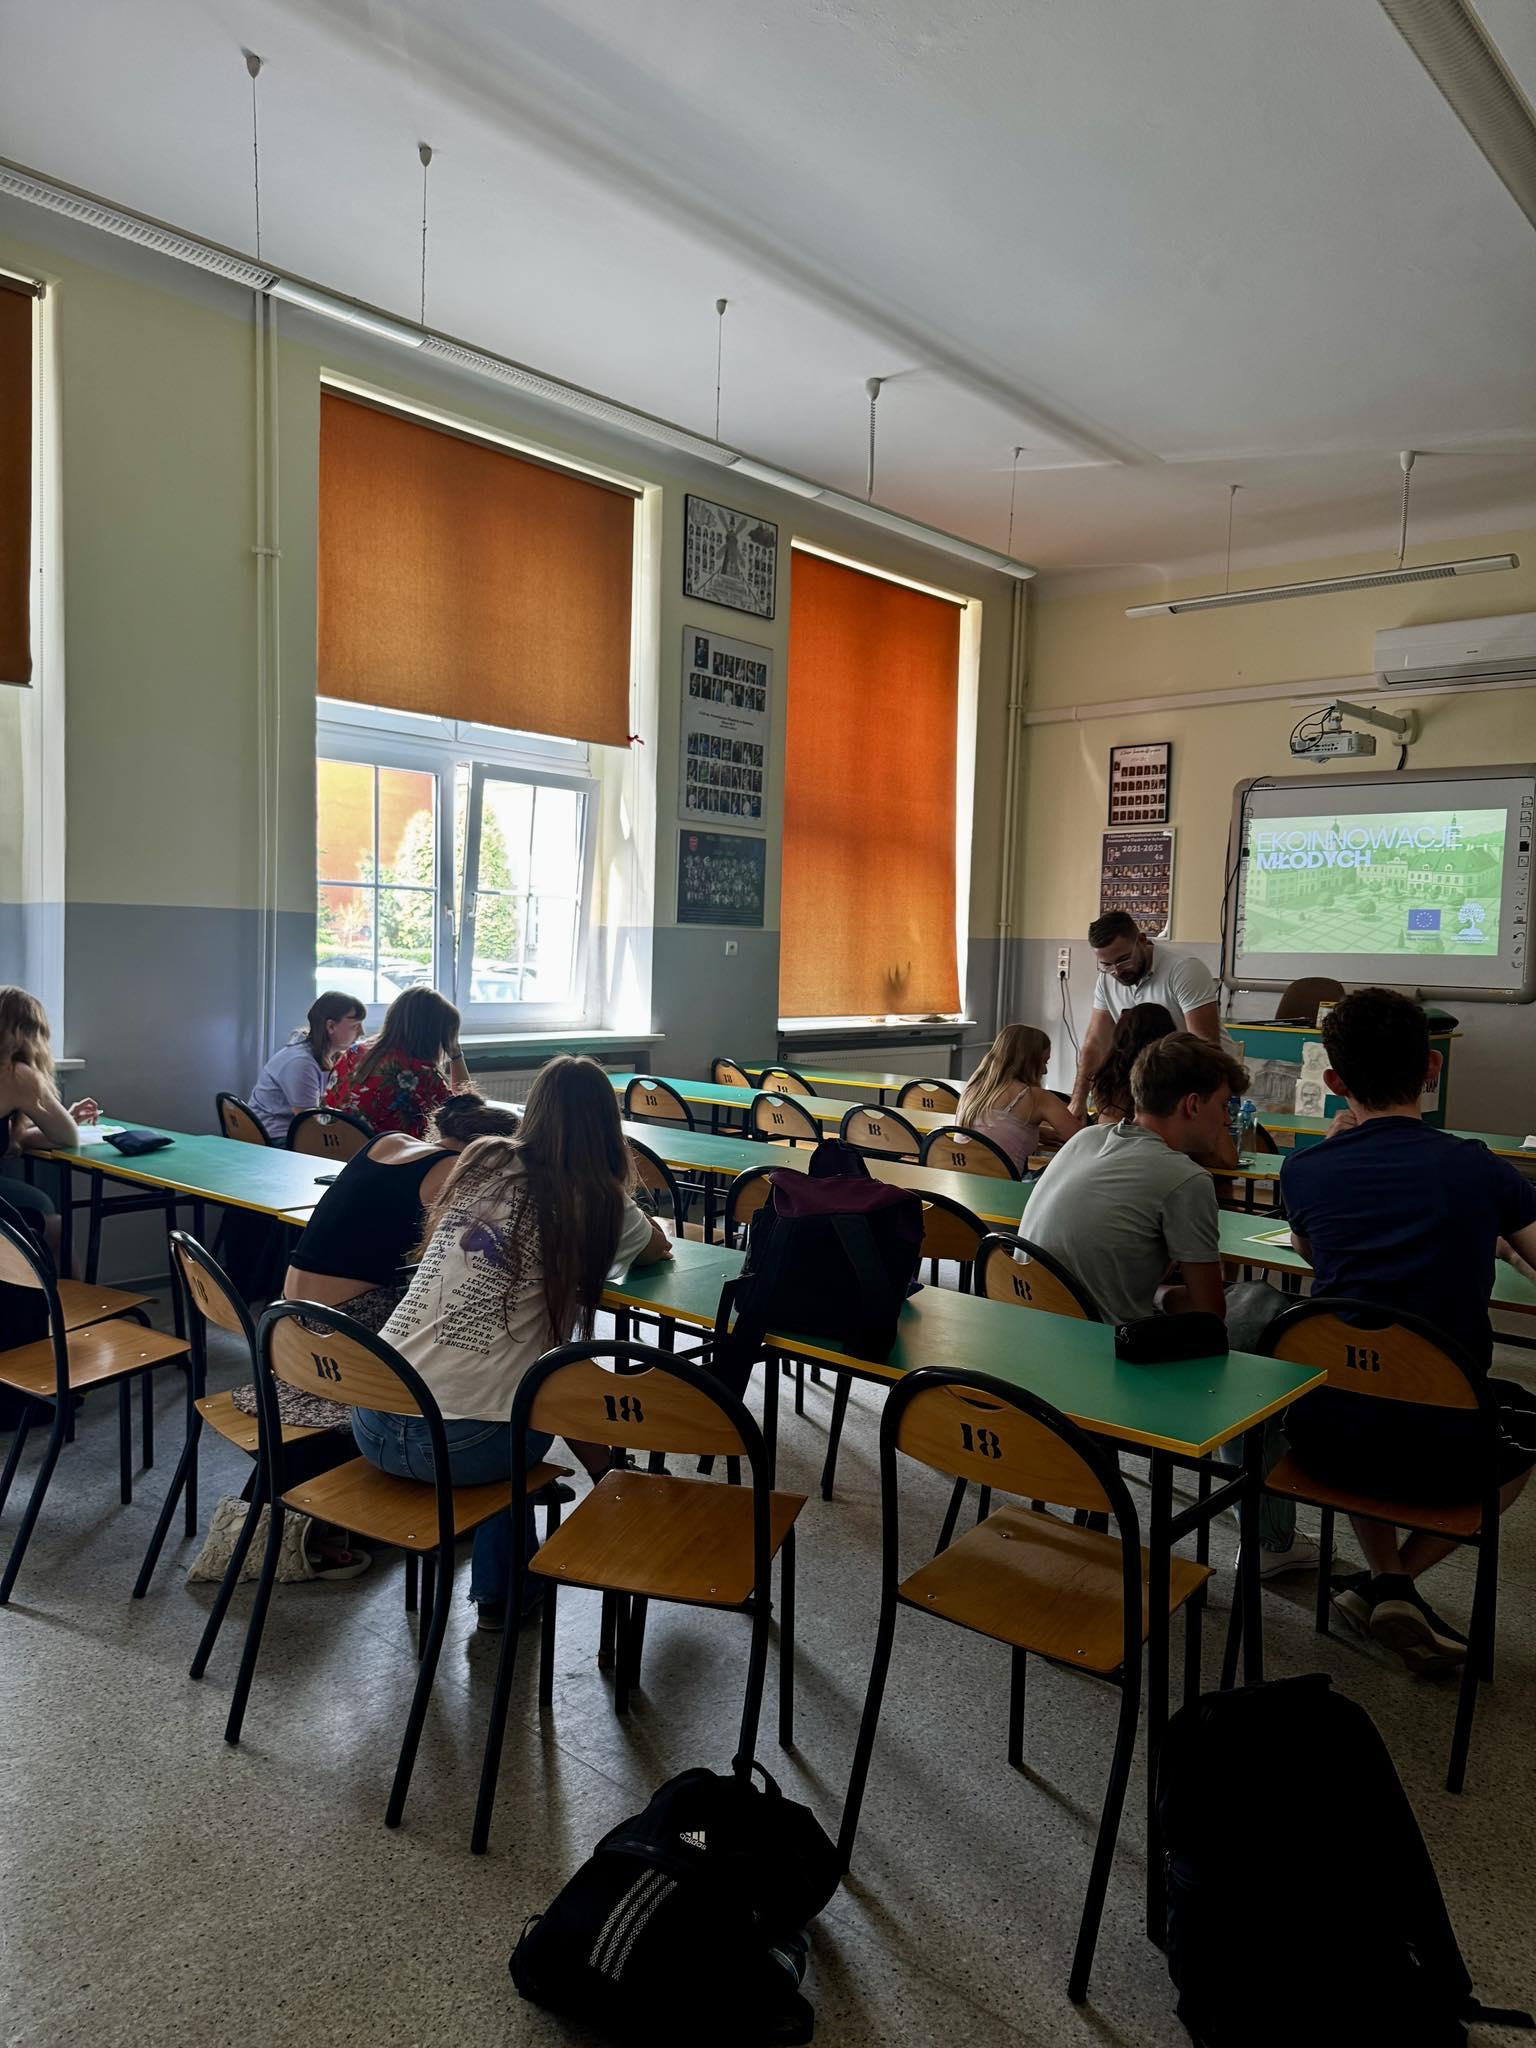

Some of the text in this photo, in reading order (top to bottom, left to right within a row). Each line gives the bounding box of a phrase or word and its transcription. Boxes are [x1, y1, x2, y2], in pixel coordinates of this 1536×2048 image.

[1256, 825, 1464, 852] EKOINNOWACJE
[1122, 844, 1164, 853] 2021-2025
[1256, 849, 1371, 870] MŁODYCH
[645, 1095, 658, 1106] 18
[922, 1098, 934, 1109] 18
[771, 1113, 784, 1124] 18
[867, 1123, 882, 1136] 18
[322, 1134, 340, 1147] 18
[951, 1152, 966, 1167] 18
[1012, 1275, 1032, 1300] 18
[310, 1352, 342, 1382] 18
[1344, 1344, 1380, 1373] 18
[603, 1395, 644, 1423] 18
[960, 1423, 1003, 1459] 18
[679, 1832, 707, 1851] adidas
